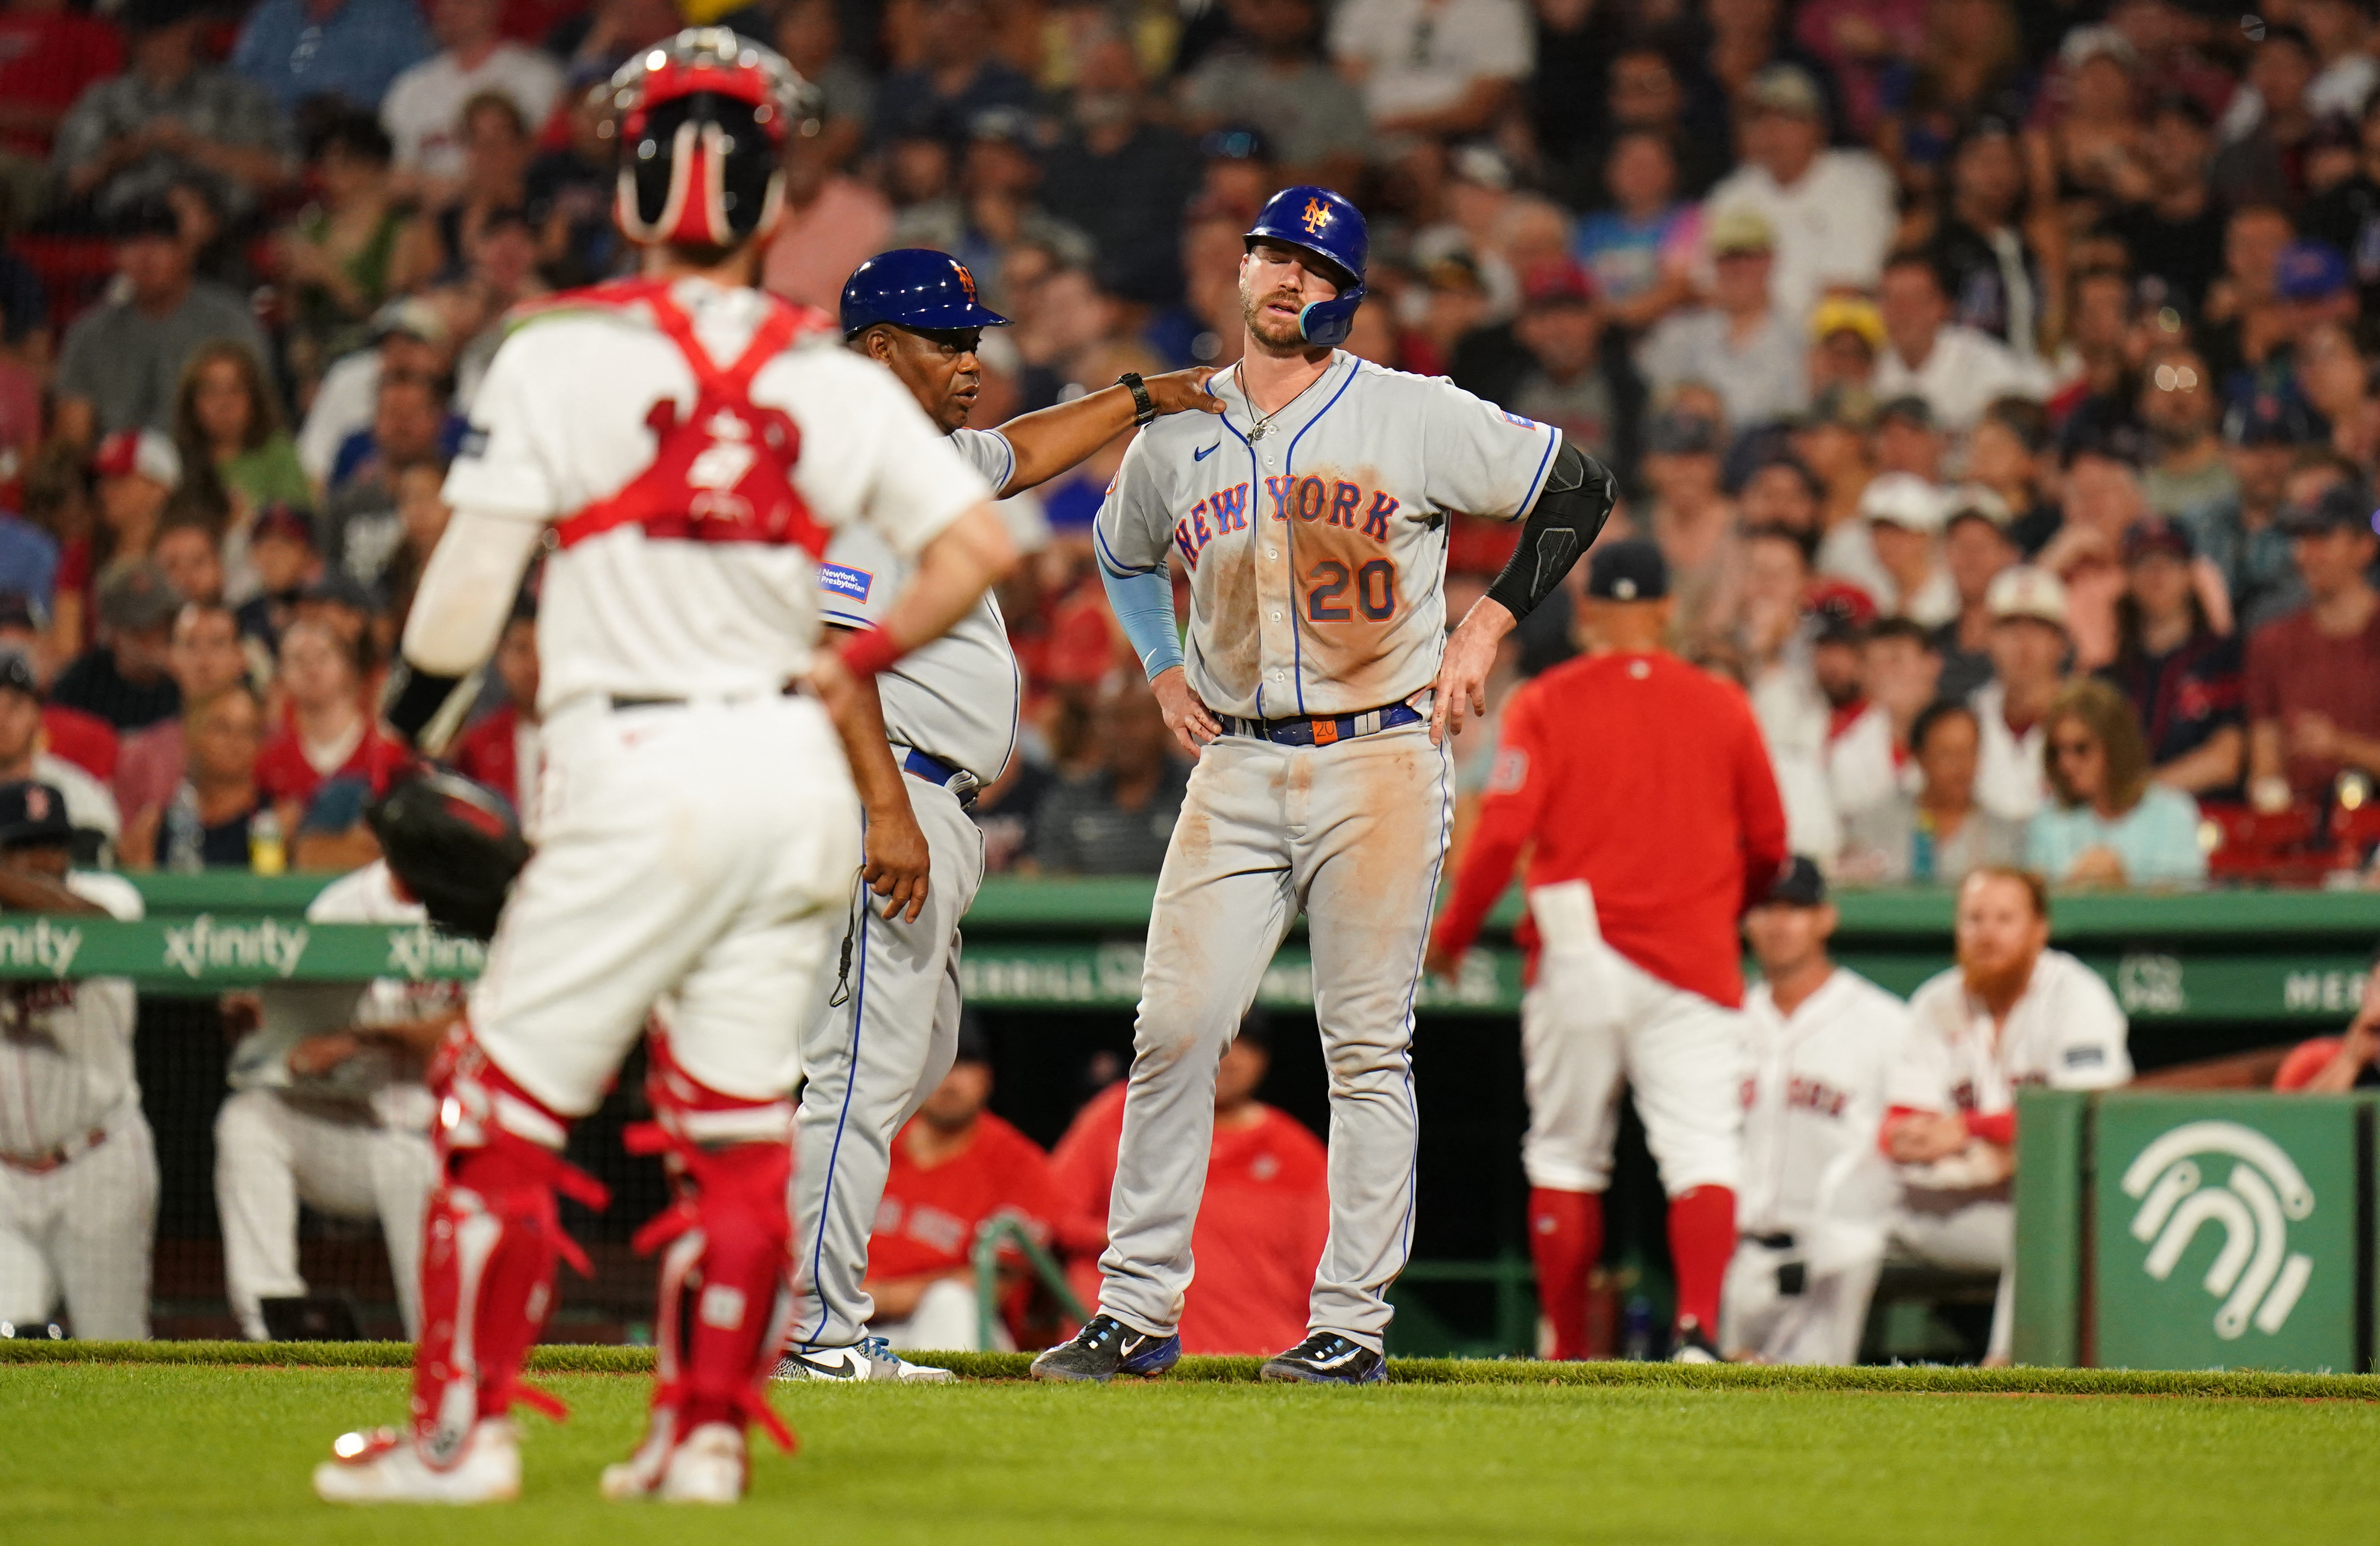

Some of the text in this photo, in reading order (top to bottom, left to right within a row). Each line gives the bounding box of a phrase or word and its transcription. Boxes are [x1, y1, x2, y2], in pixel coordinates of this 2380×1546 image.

[1175, 474, 1400, 571] NEW YORK
[821, 576, 865, 593] Presbyterian
[822, 568, 858, 583] NewYork-
[1306, 557, 1397, 623] 20
[1315, 721, 1334, 737] 20
[162, 913, 310, 979] xfinity
